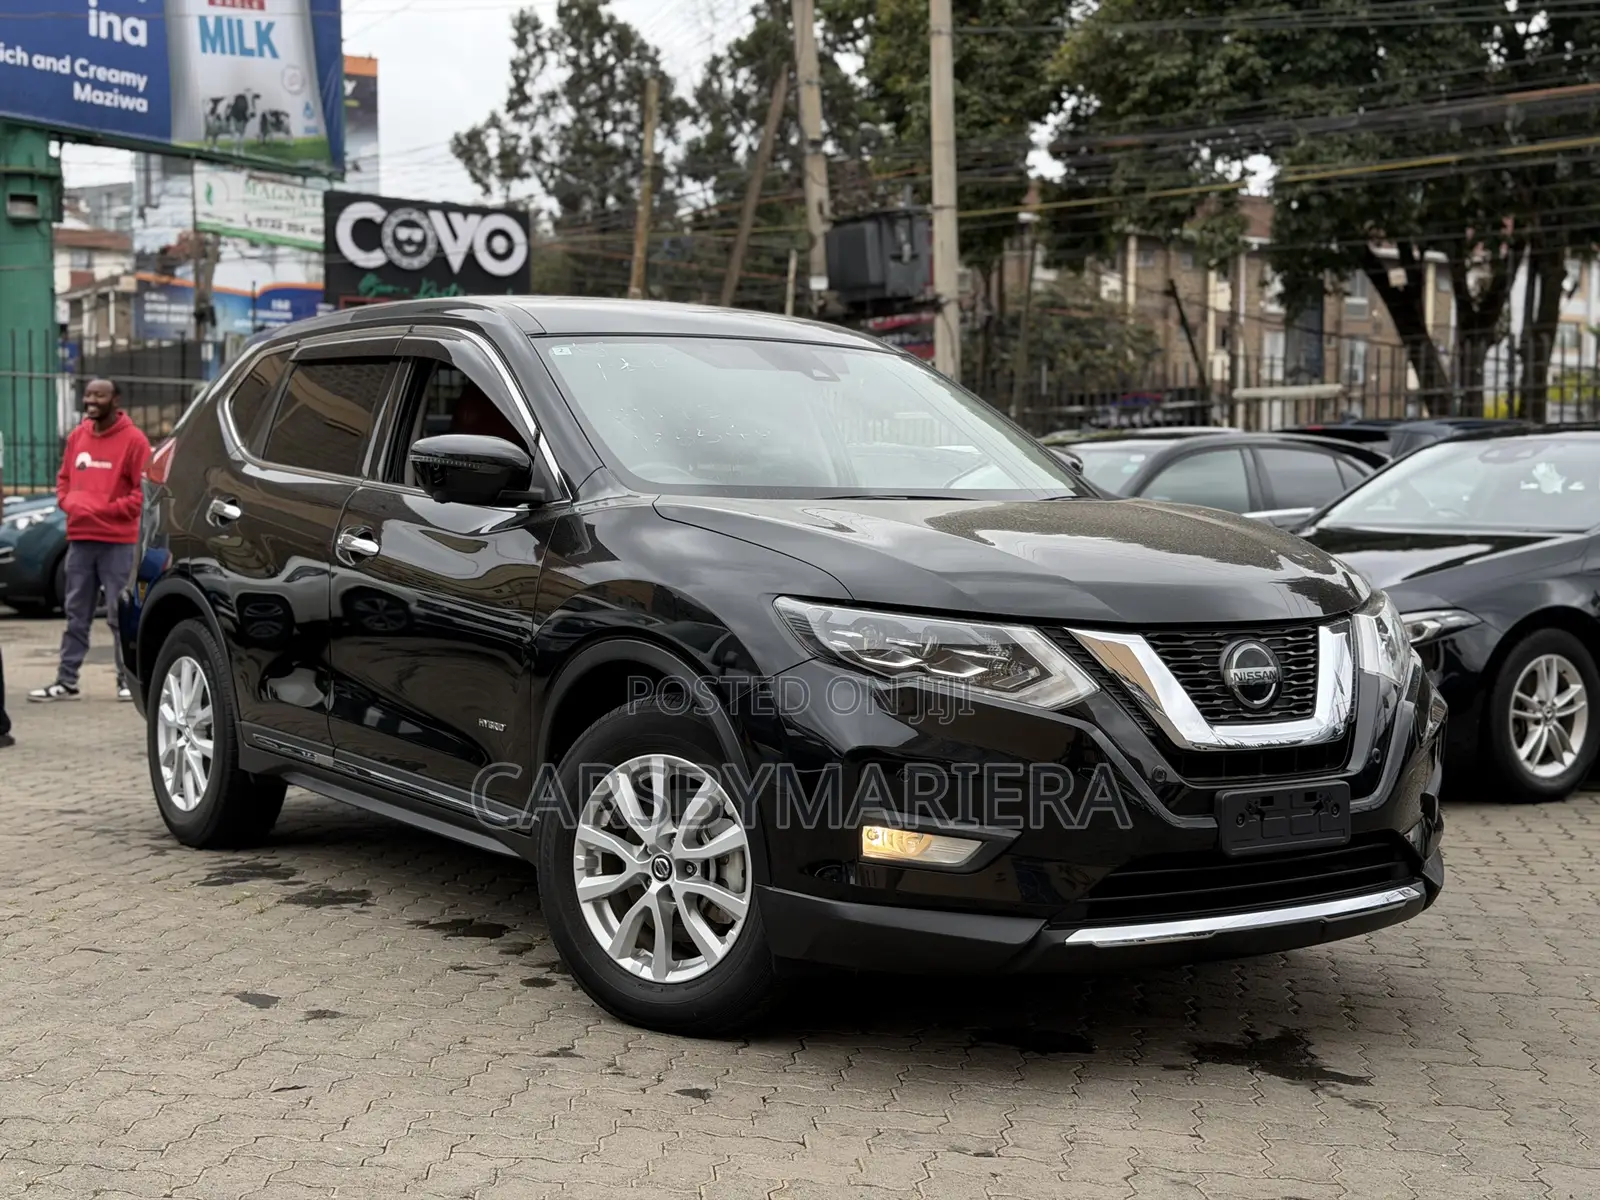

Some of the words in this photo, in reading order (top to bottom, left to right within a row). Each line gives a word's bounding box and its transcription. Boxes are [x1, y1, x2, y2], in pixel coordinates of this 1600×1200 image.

[199, 15, 279, 59] MILK
[31, 53, 72, 75] and
[73, 58, 148, 93] Creamy
[72, 80, 148, 113] Maziwa
[335, 200, 529, 277] COVO
[1233, 670, 1277, 682] NISSAN
